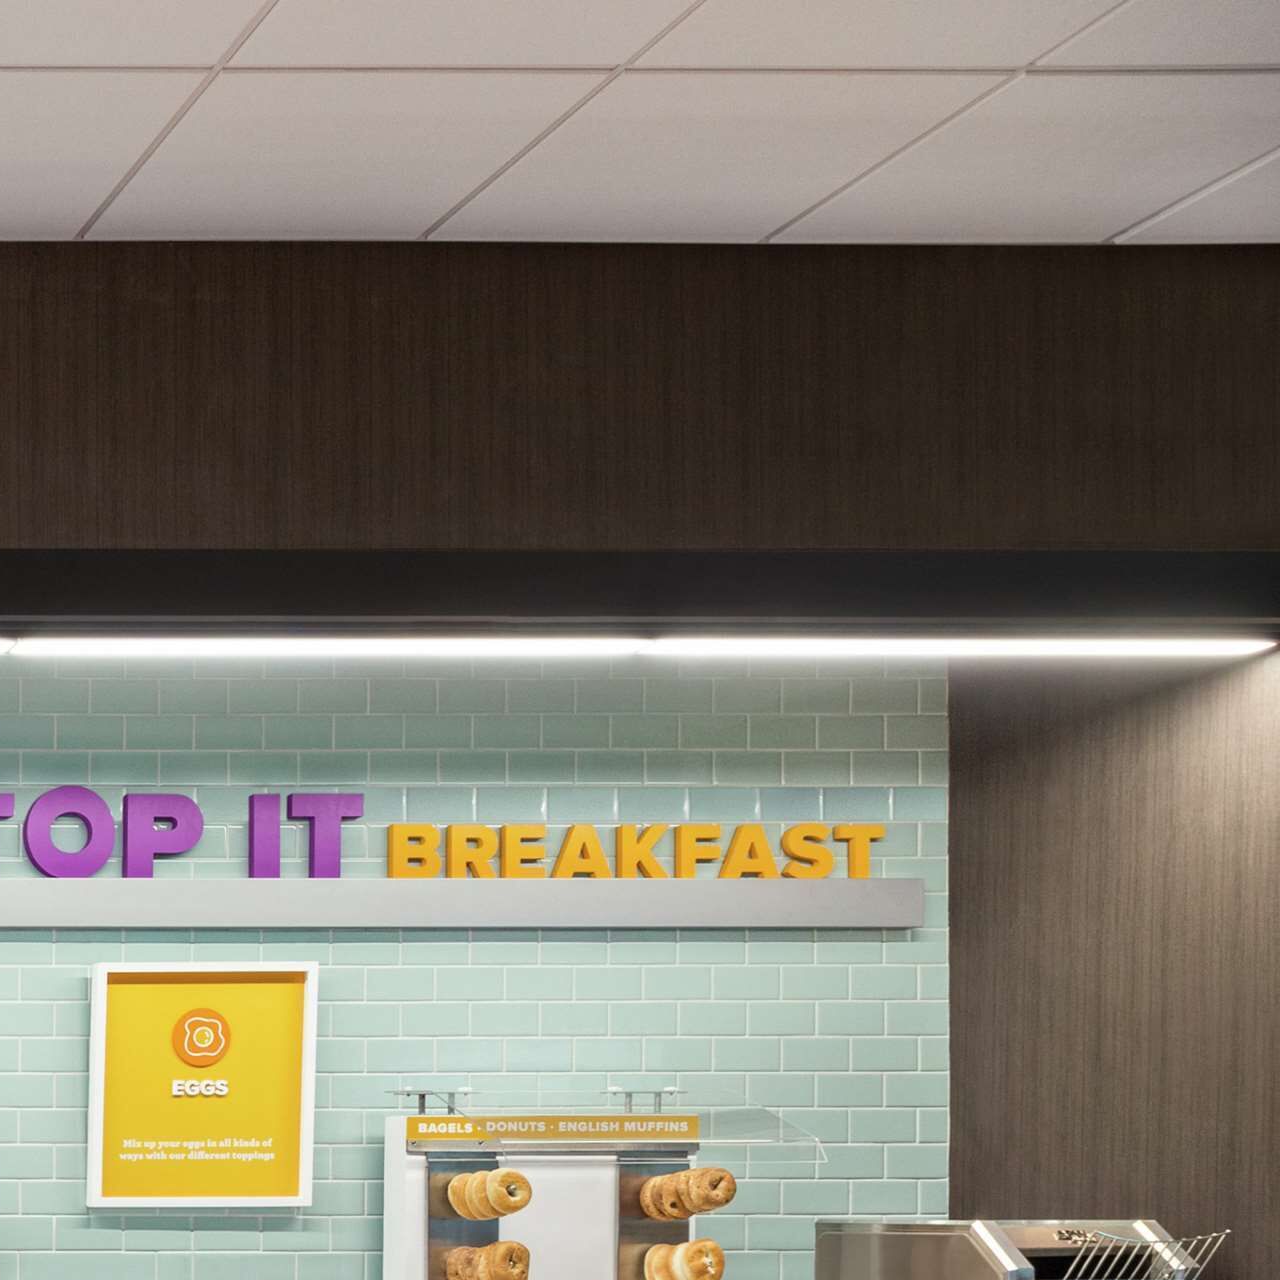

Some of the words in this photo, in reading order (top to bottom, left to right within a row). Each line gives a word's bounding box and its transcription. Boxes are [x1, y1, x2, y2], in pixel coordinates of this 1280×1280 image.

[248, 793, 365, 879] IT
[387, 823, 887, 880] BREAKFAST
[171, 1079, 230, 1097] EGGS
[418, 1122, 473, 1134] BAGELS
[486, 1120, 546, 1132] DONUTS
[558, 1121, 620, 1132] ENGLISH
[623, 1121, 689, 1132] MUFFINS
[122, 1139, 142, 1148] Mix
[144, 1141, 157, 1151] up
[158, 1141, 181, 1151] your
[182, 1141, 206, 1151] eggs
[207, 1139, 217, 1148] in
[218, 1139, 231, 1148] all
[233, 1138, 260, 1148] kinds
[262, 1138, 273, 1148] of
[119, 1152, 144, 1161] ways
[145, 1151, 168, 1160] with
[169, 1152, 186, 1160] our
[187, 1150, 230, 1160] different
[232, 1151, 275, 1161] toppings
